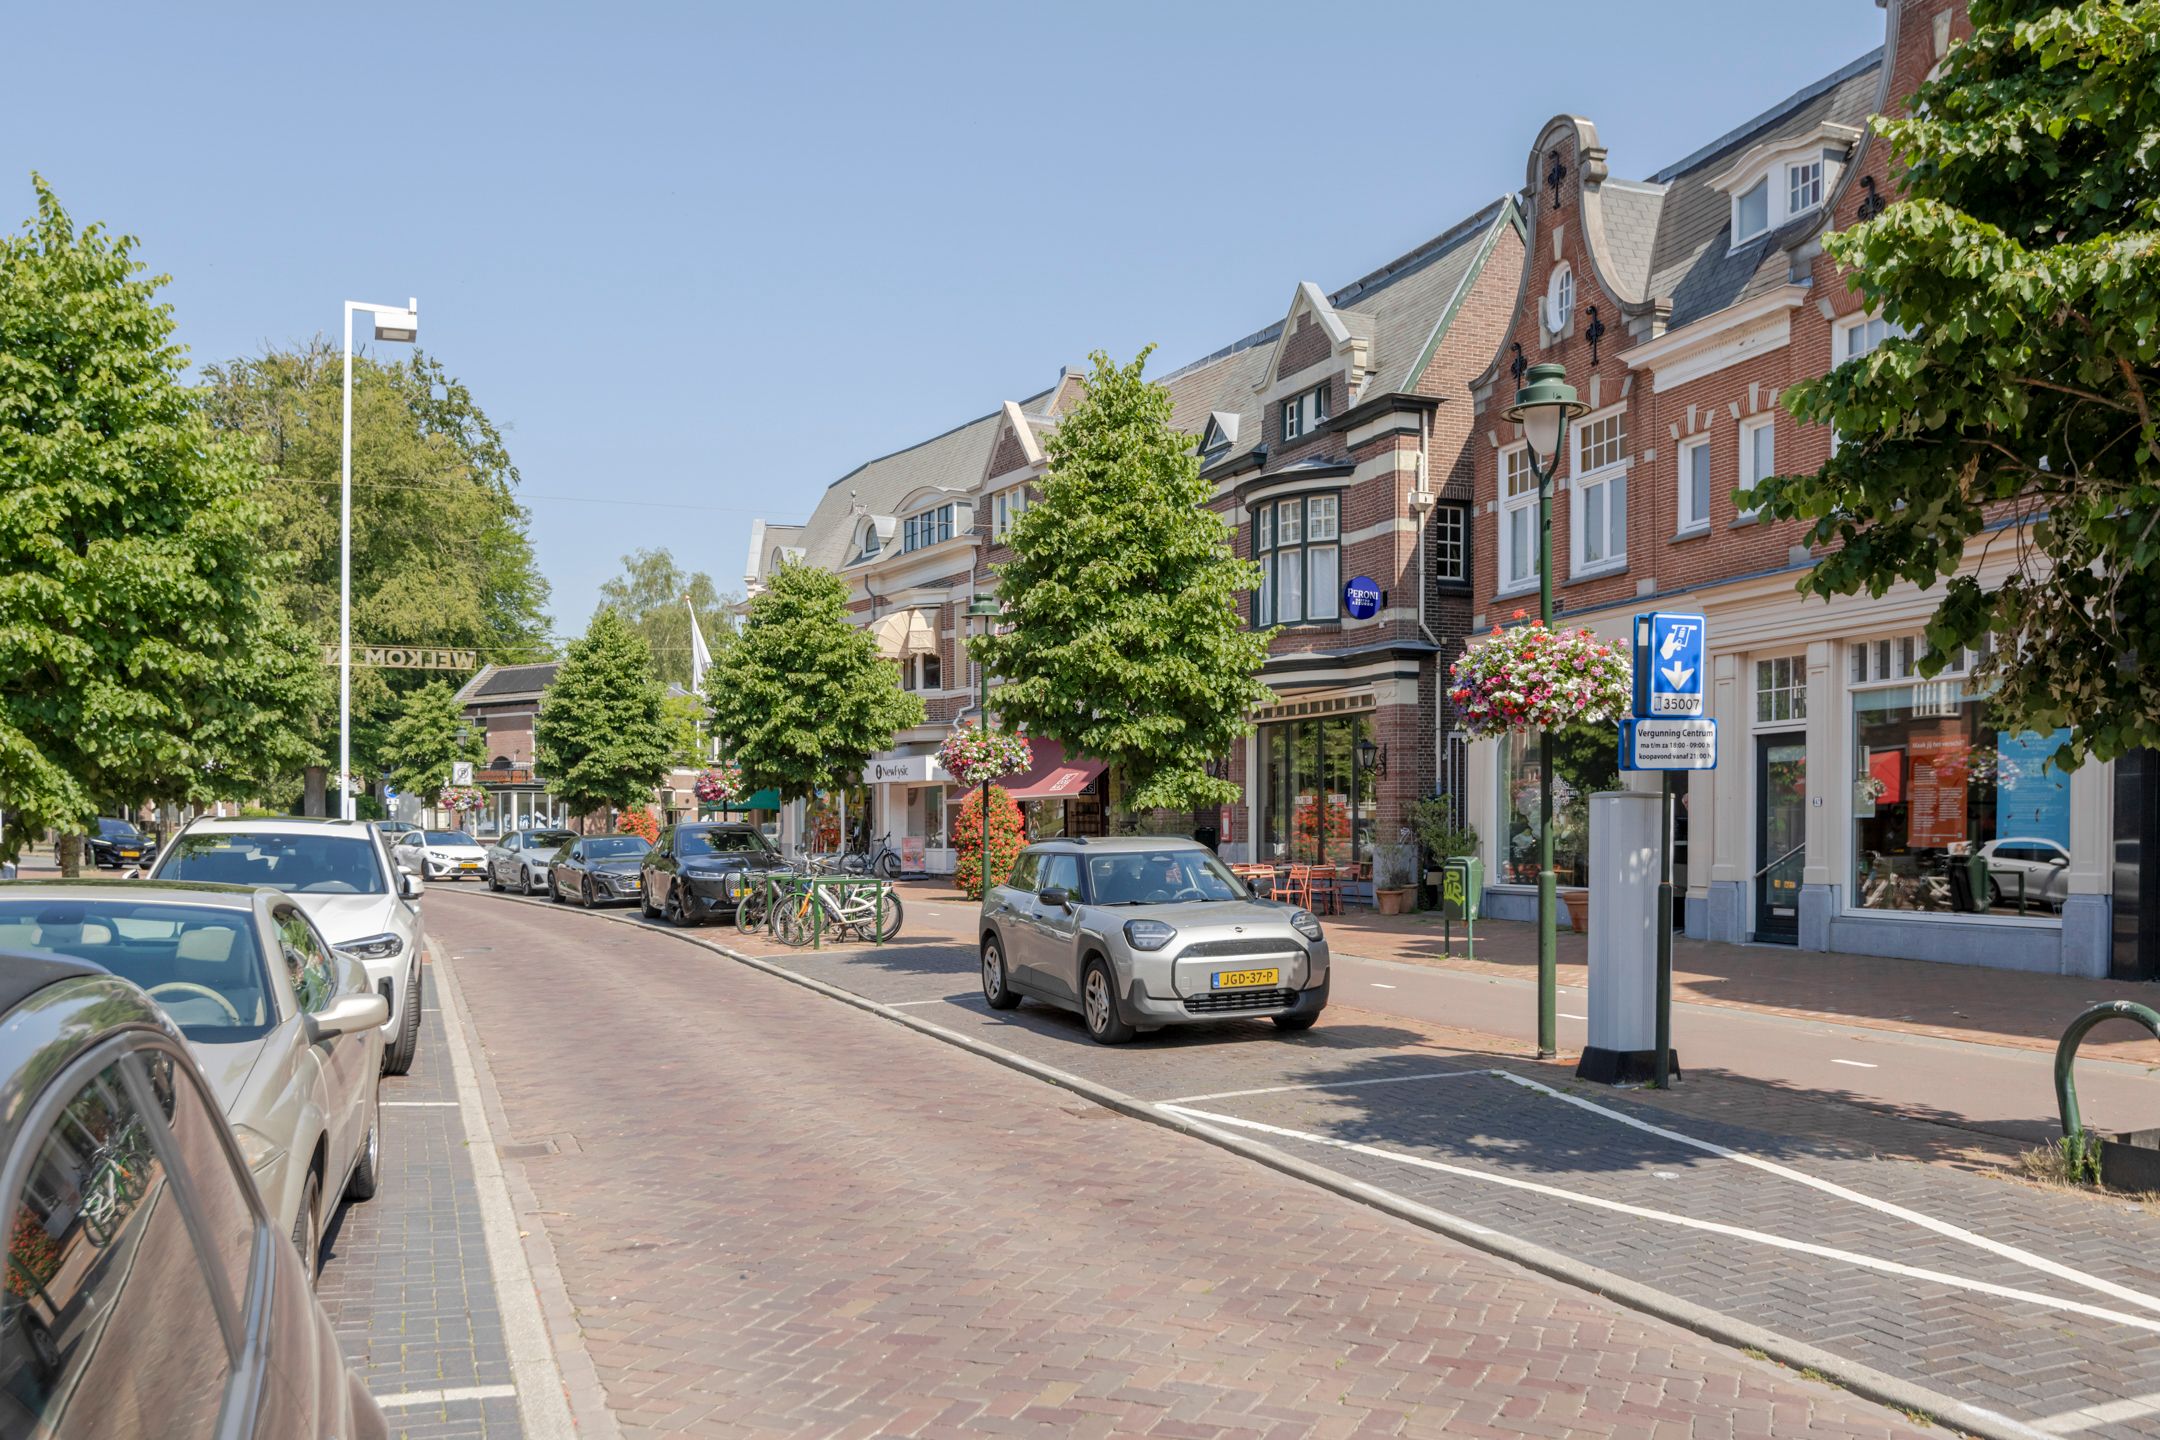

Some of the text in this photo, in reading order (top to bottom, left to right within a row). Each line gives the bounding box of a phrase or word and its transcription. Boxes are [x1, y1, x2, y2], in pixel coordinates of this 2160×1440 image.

[1347, 588, 1379, 600] PERONI
[1664, 698, 1700, 710] 35007
[1638, 729, 1713, 739] Vergunning Centrum
[1223, 971, 1273, 986] JGD-37-P
